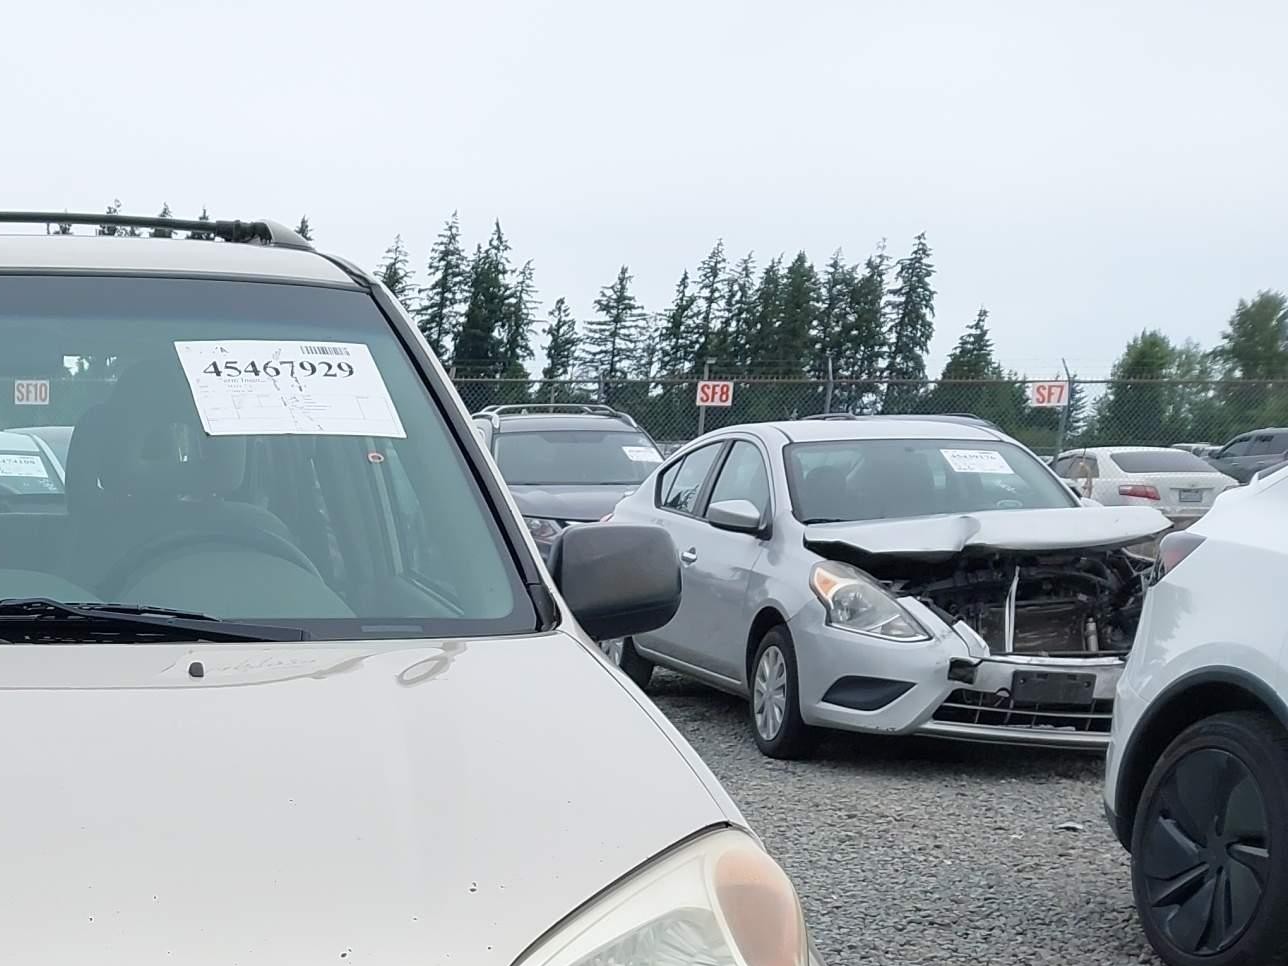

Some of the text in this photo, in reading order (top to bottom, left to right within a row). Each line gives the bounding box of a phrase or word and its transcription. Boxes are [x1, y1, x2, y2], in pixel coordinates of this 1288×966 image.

[202, 360, 355, 378] 45467929
[16, 382, 48, 403] SF10
[700, 383, 730, 403] SF8
[1035, 384, 1065, 404] SF7
